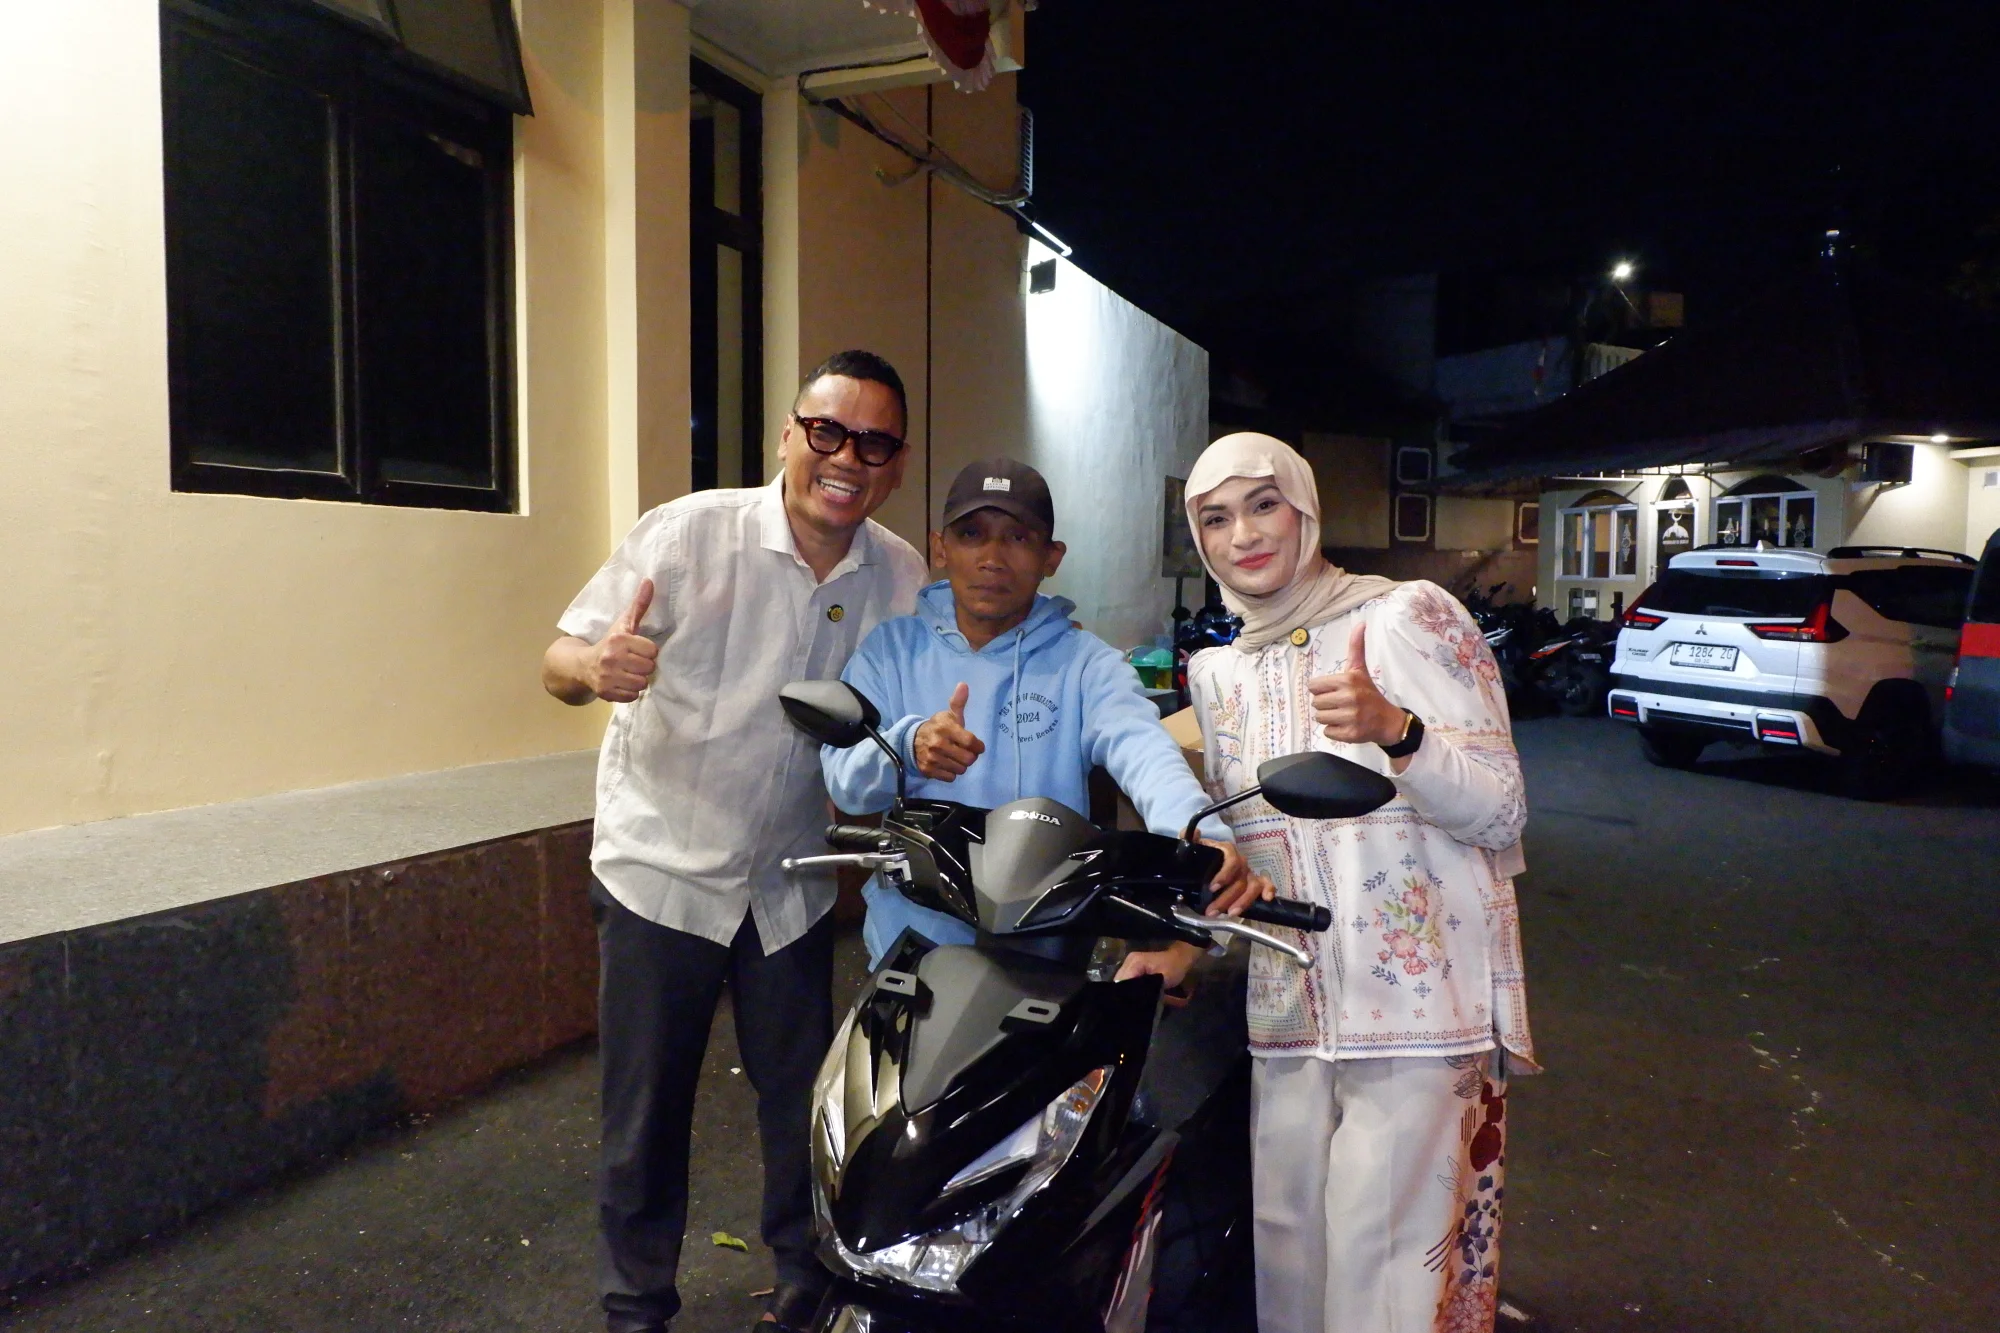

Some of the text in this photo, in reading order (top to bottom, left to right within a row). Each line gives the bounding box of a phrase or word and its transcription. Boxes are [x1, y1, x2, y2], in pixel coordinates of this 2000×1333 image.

[1674, 644, 1682, 655] F
[1689, 646, 1713, 657] 1284
[1030, 692, 1058, 713] GENERATION
[1016, 711, 1040, 724] 2024
